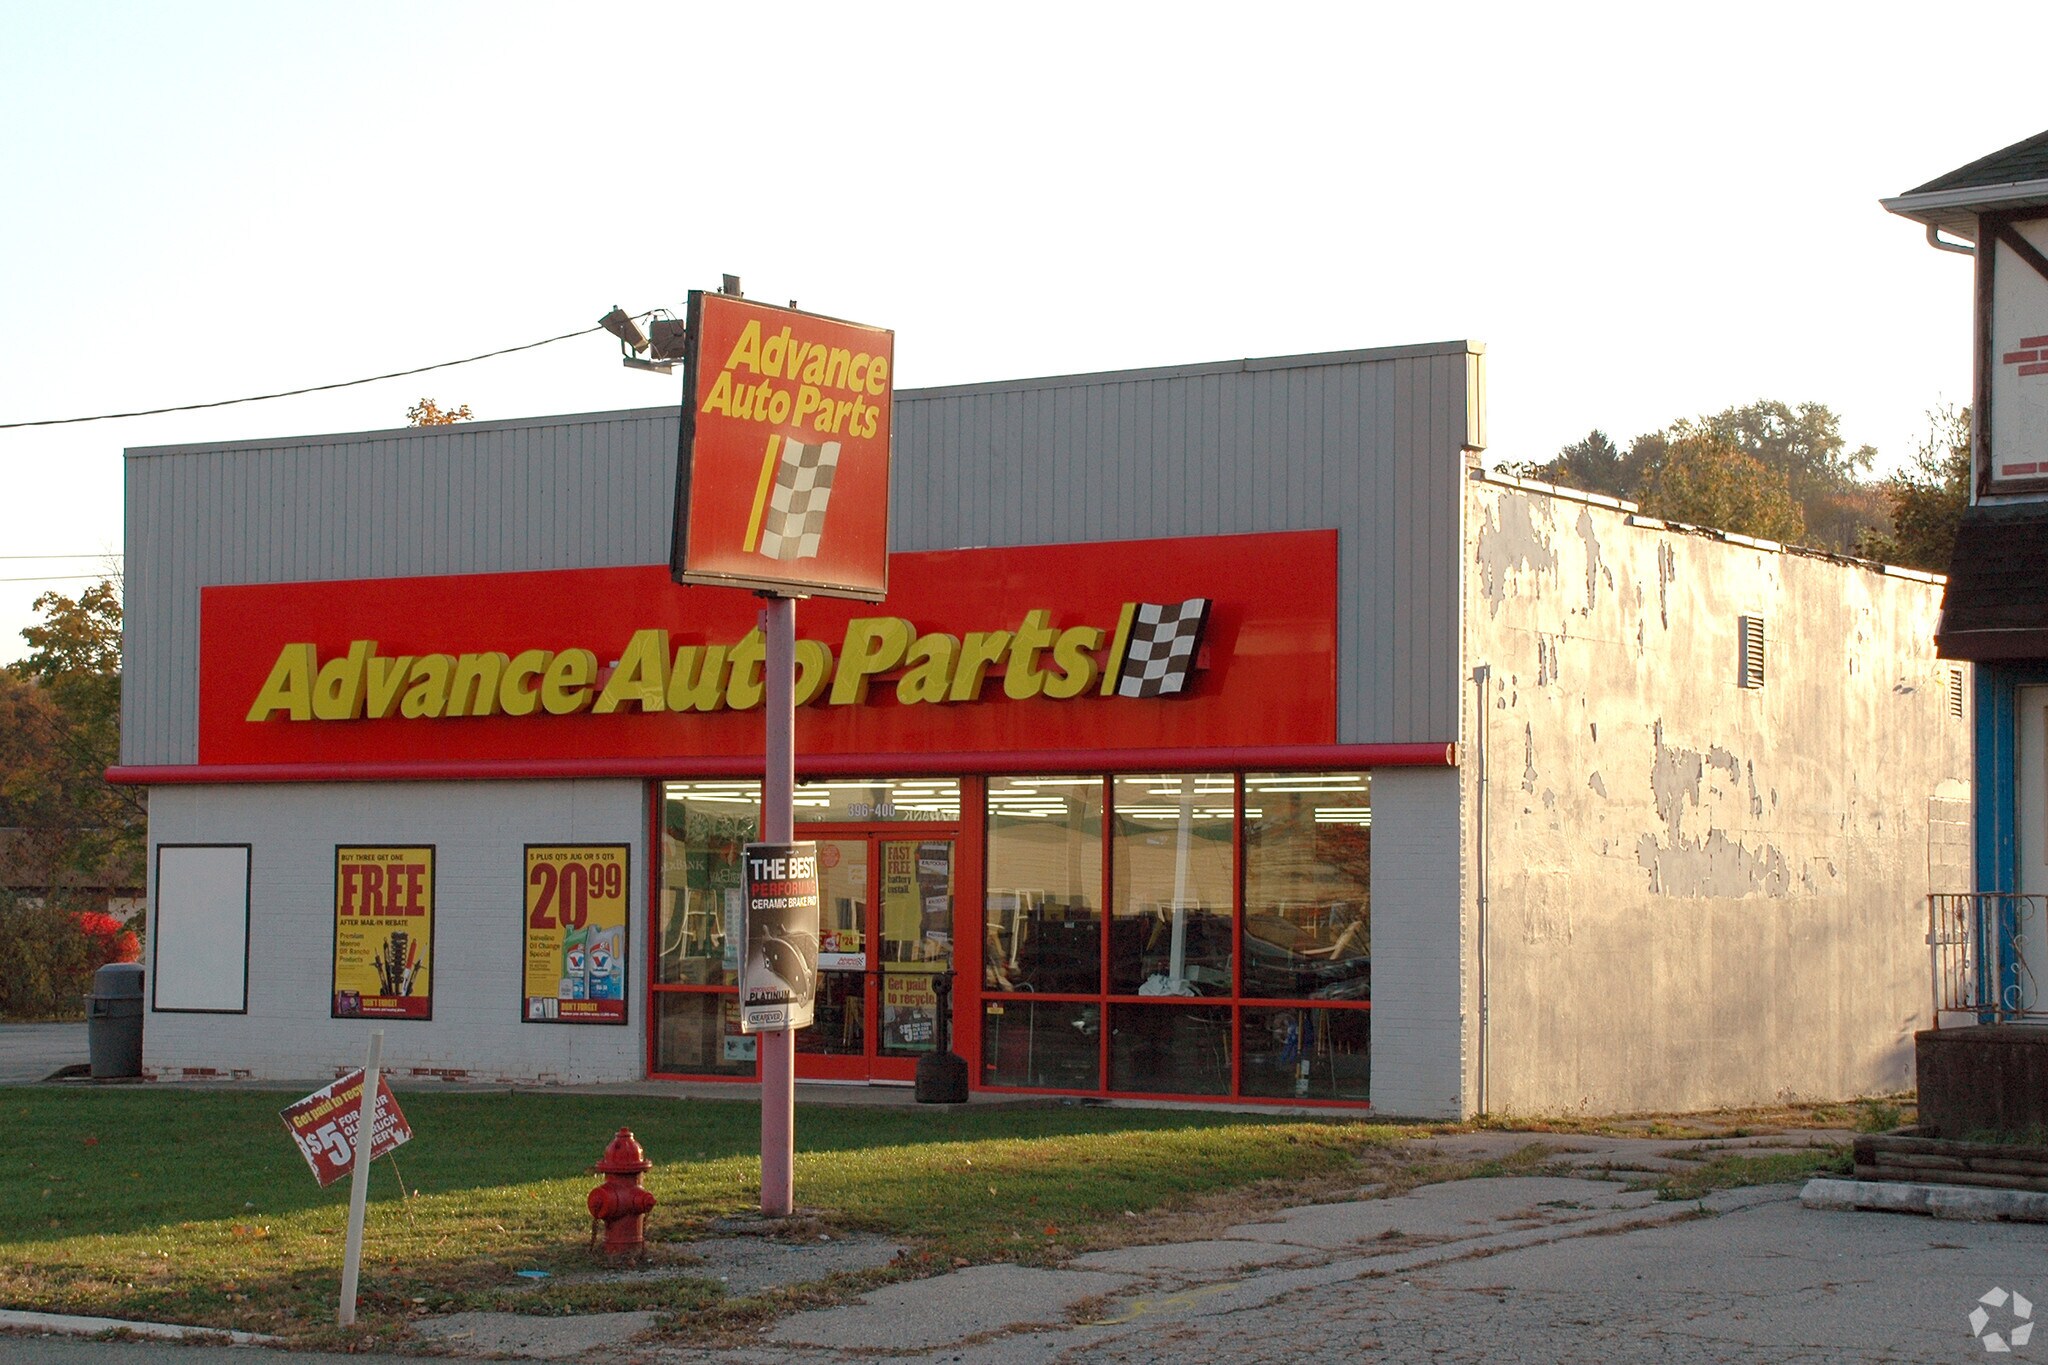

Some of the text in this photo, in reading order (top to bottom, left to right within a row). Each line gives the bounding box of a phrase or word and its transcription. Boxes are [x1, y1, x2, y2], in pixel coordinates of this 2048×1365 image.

[725, 320, 888, 395] Advance
[701, 371, 880, 439] Auto Parts
[245, 609, 1106, 721] Advance Auto Parts
[848, 803, 895, 817] 396-400
[887, 847, 911, 860] FAST
[750, 859, 786, 880] THE
[789, 857, 815, 879] BEST
[887, 861, 911, 875] FREE
[887, 874, 911, 885] battery
[341, 864, 425, 916] FREE
[751, 881, 816, 897] PERFORMING
[751, 898, 787, 910] CERAMIC
[788, 896, 807, 908] BRAKE
[385, 919, 408, 927] REBATE
[888, 977, 927, 993] Get paid
[750, 990, 790, 1000] PLATINUM
[888, 992, 897, 1004] to
[293, 1111, 313, 1128] Get
[310, 1098, 334, 1120] paid
[331, 1096, 344, 1108] to
[338, 1110, 360, 1127] FOR
[374, 1107, 387, 1120] AR
[372, 1113, 398, 1134] RUCK
